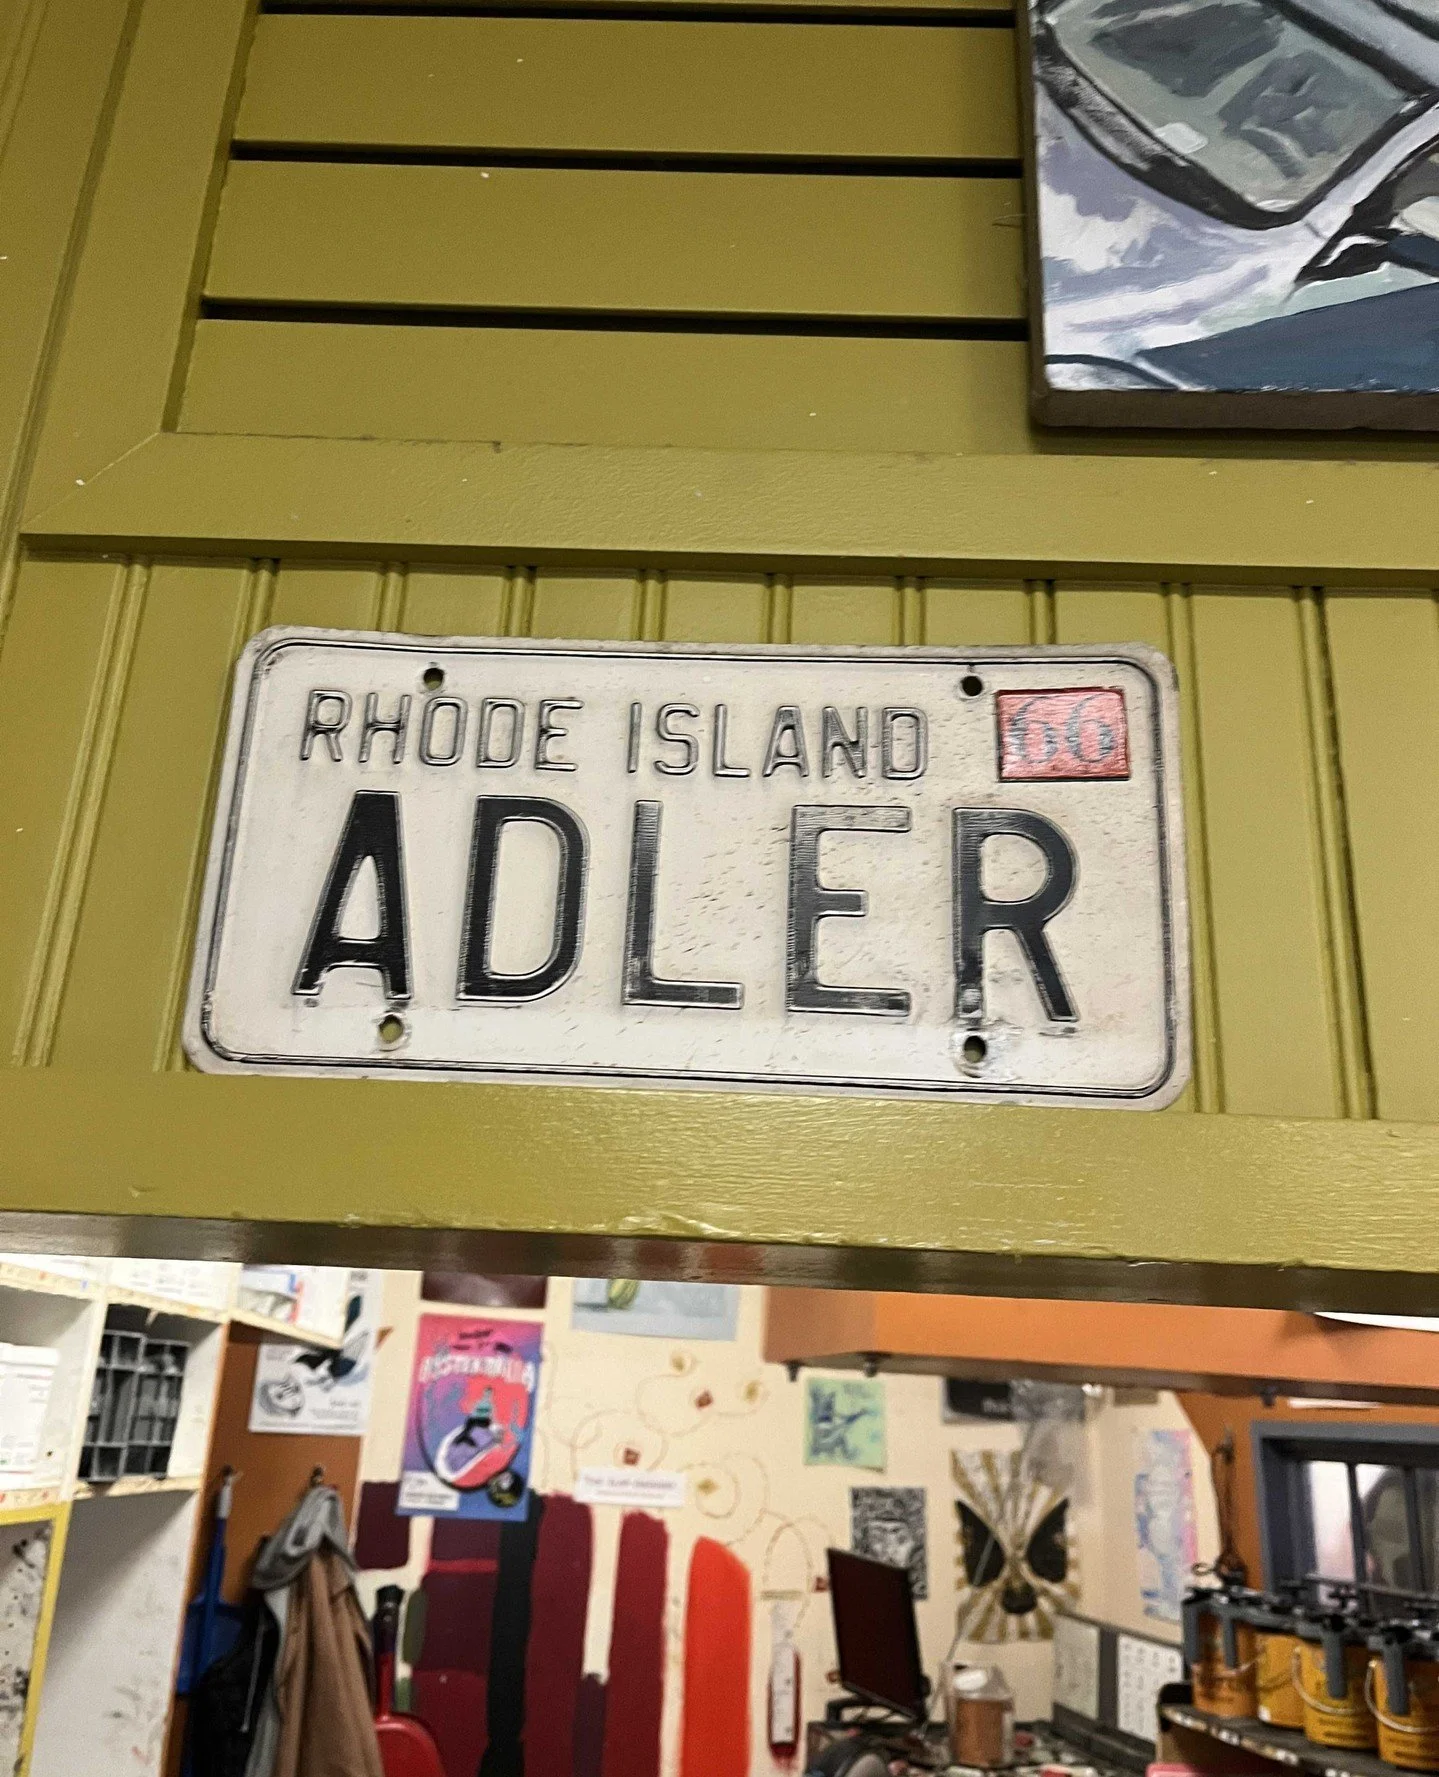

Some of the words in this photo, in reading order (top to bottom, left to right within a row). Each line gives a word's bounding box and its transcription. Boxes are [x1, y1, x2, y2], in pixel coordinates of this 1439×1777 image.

[300, 689, 584, 771] RHODE
[627, 702, 929, 778] ISLAND
[1006, 694, 1115, 766] 66
[291, 790, 1079, 1021] ADLER
